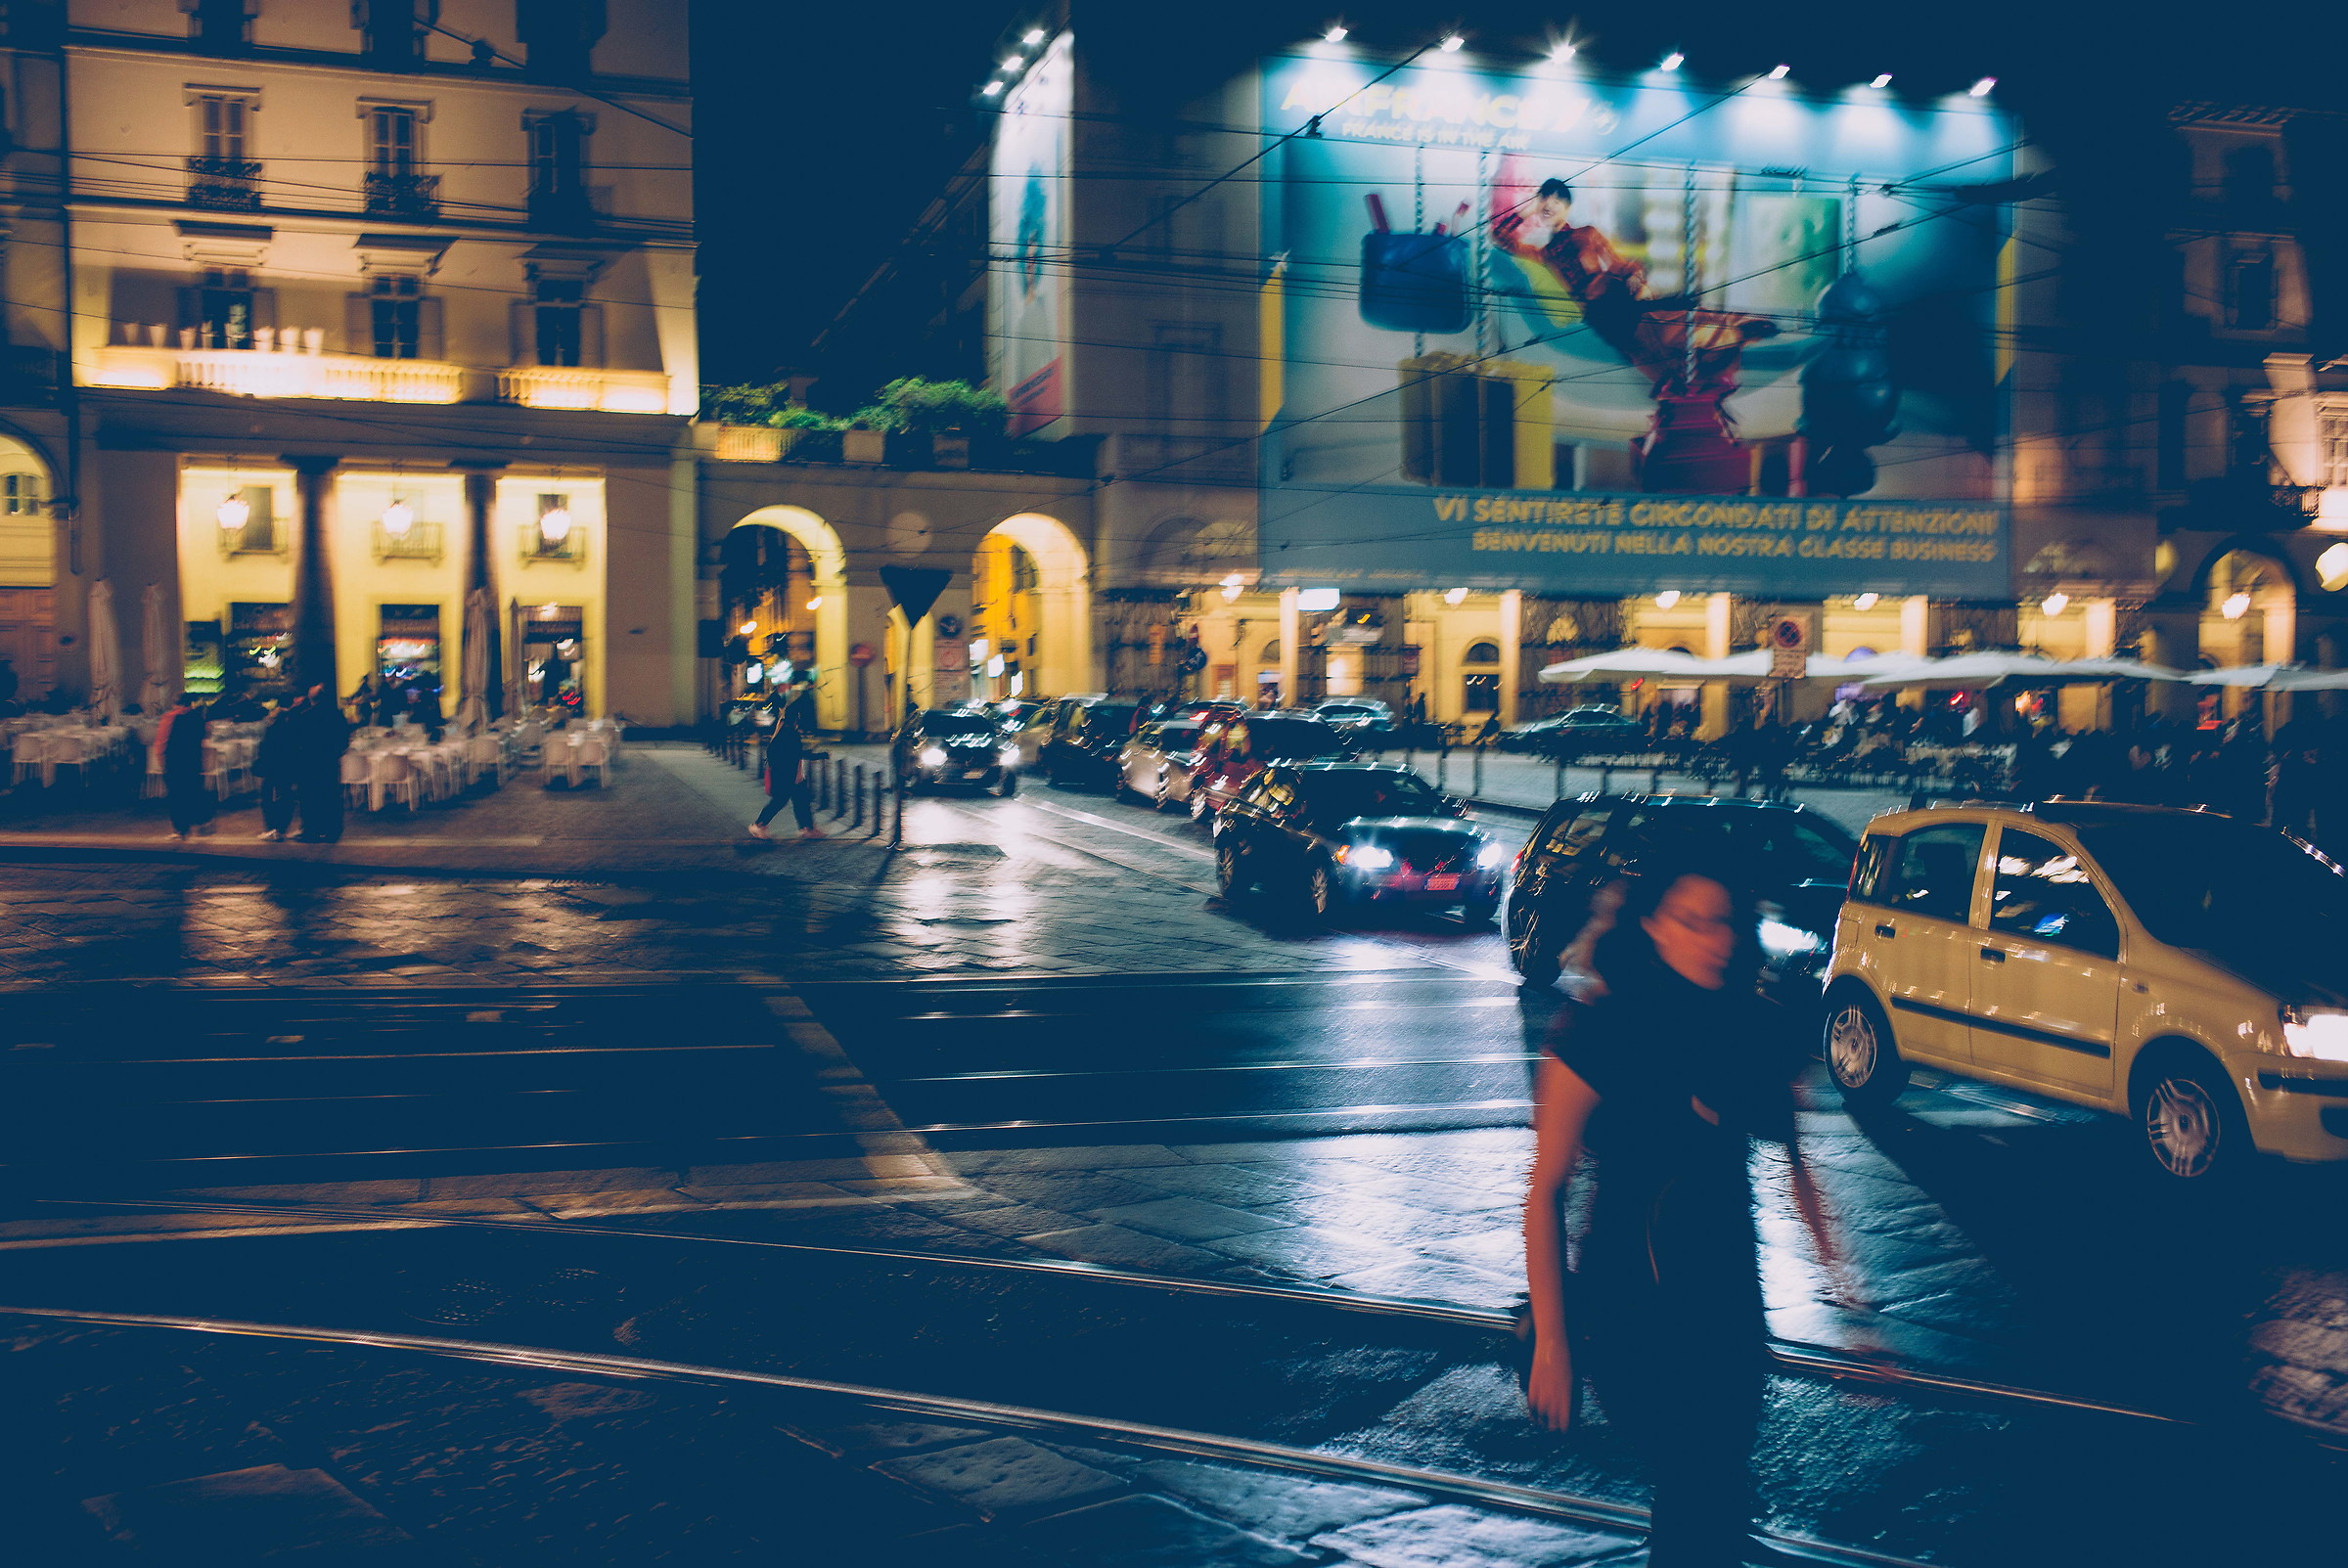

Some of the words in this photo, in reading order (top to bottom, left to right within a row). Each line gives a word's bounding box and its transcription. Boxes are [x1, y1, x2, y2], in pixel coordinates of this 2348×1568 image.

[1342, 118, 1413, 141] FRANCE
[1433, 495, 1468, 521] VI
[1473, 497, 1624, 525] SENTIRETE
[1629, 501, 1802, 529] CIRCONDATI
[1806, 504, 1836, 530] DI
[1840, 507, 1998, 535] ATTENZIONI
[1472, 529, 1611, 554] BENVENUTI
[1614, 532, 1693, 556] NELLA
[1696, 534, 1795, 558] NOSTRA
[1798, 537, 1887, 560] CLASSE
[1889, 540, 1998, 562] BUSINESS
